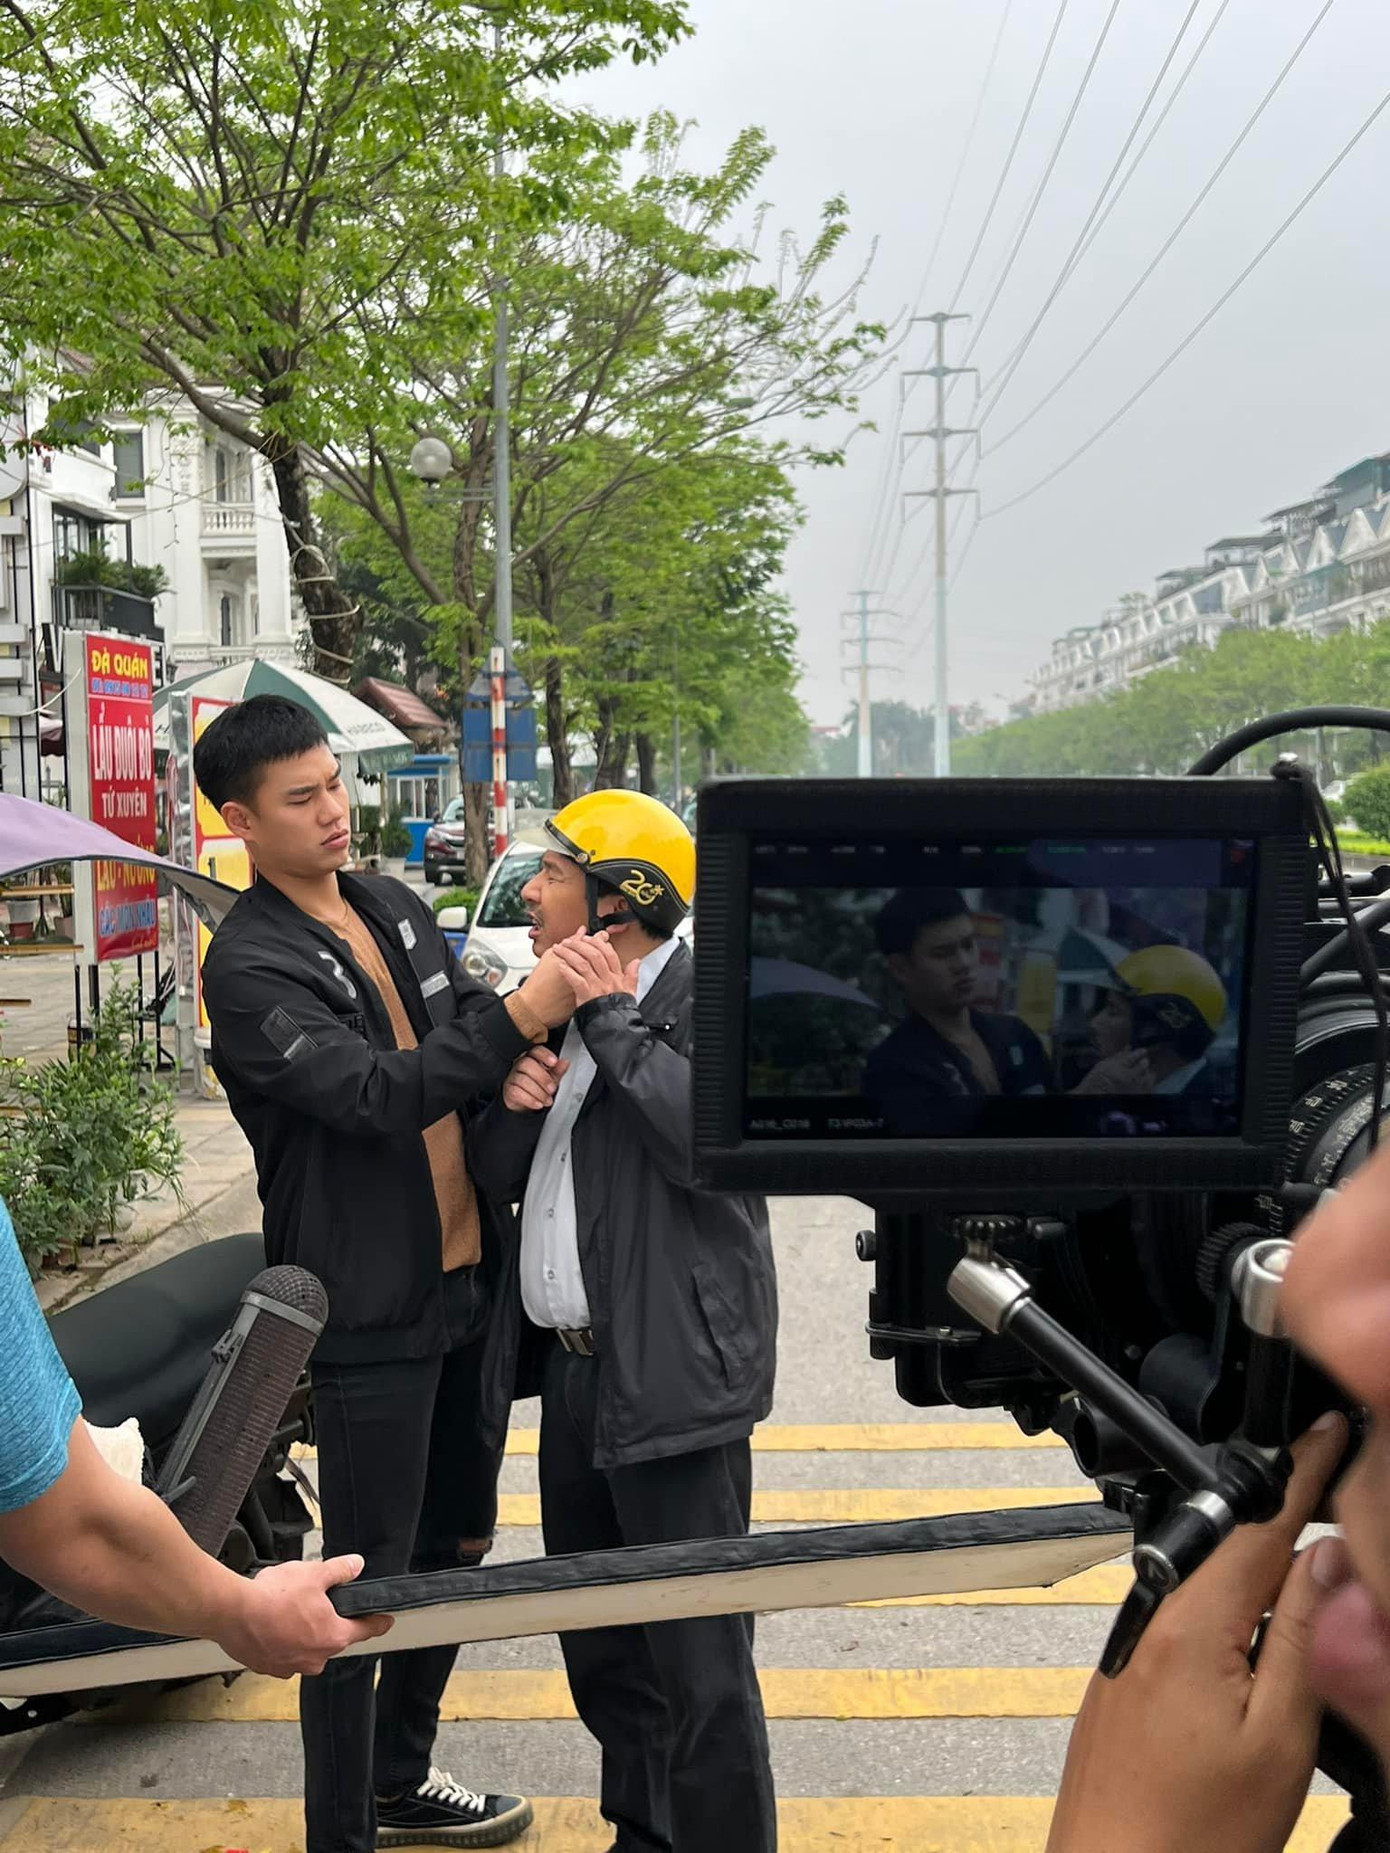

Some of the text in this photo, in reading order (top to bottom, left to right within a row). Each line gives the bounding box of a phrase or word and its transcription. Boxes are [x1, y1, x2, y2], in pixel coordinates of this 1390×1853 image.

[113, 652, 148, 679] QUÁN
[138, 714, 152, 781] BÒ
[116, 786, 147, 818] XUYÊN
